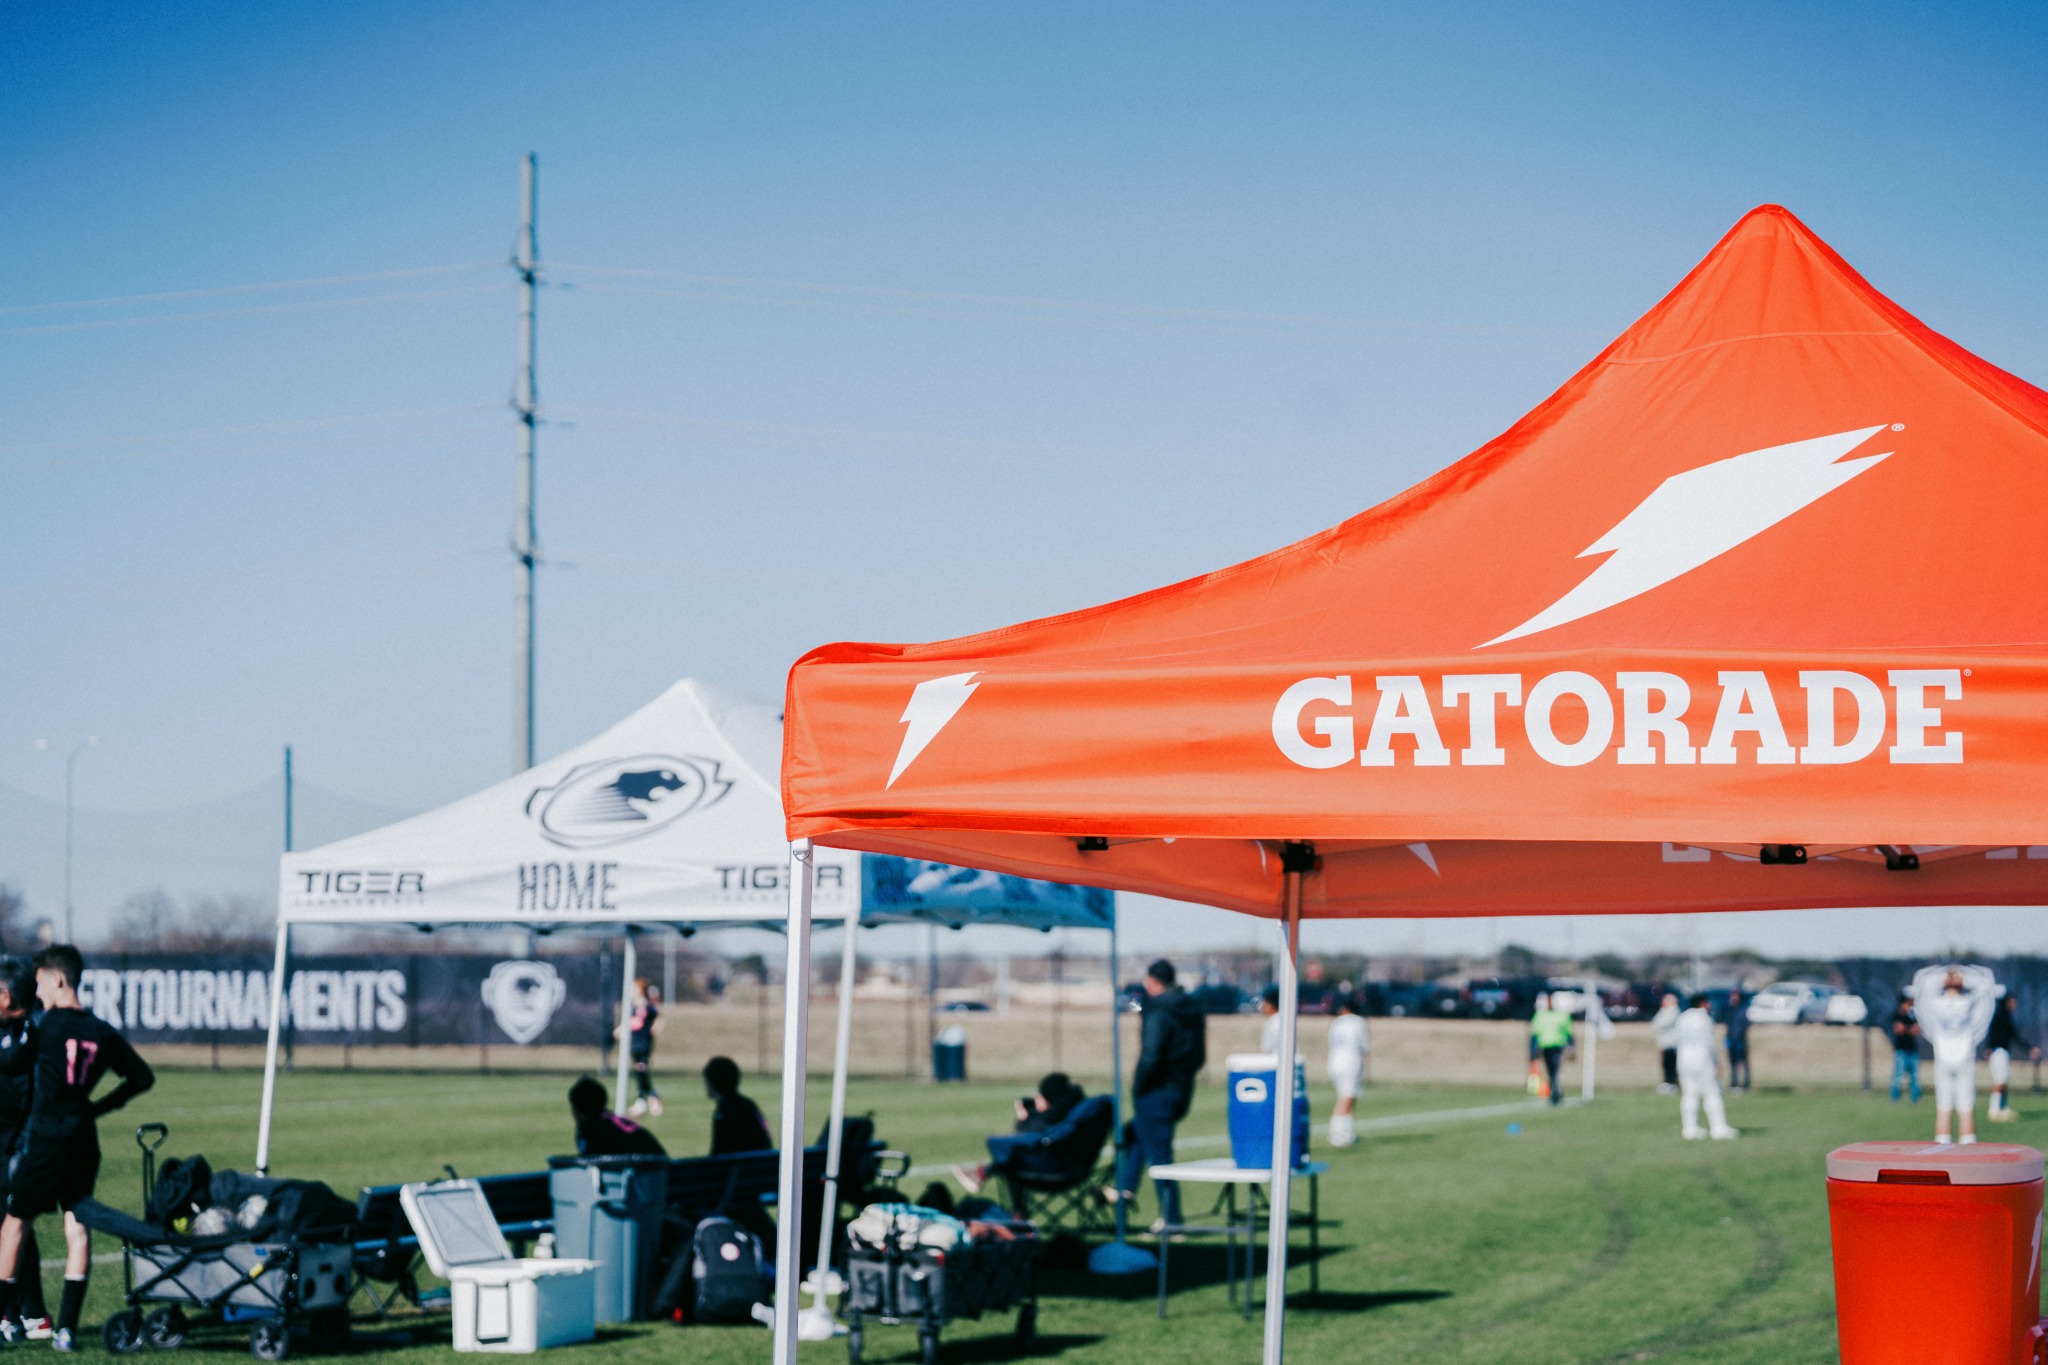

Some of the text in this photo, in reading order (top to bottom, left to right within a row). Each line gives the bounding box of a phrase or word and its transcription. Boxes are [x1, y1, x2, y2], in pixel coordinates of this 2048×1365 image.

[1272, 669, 1963, 769] GATORADE
[297, 870, 424, 894] TIGER
[518, 862, 618, 911] HOME
[713, 865, 843, 889] TIGR
[65, 1038, 98, 1085] 17
